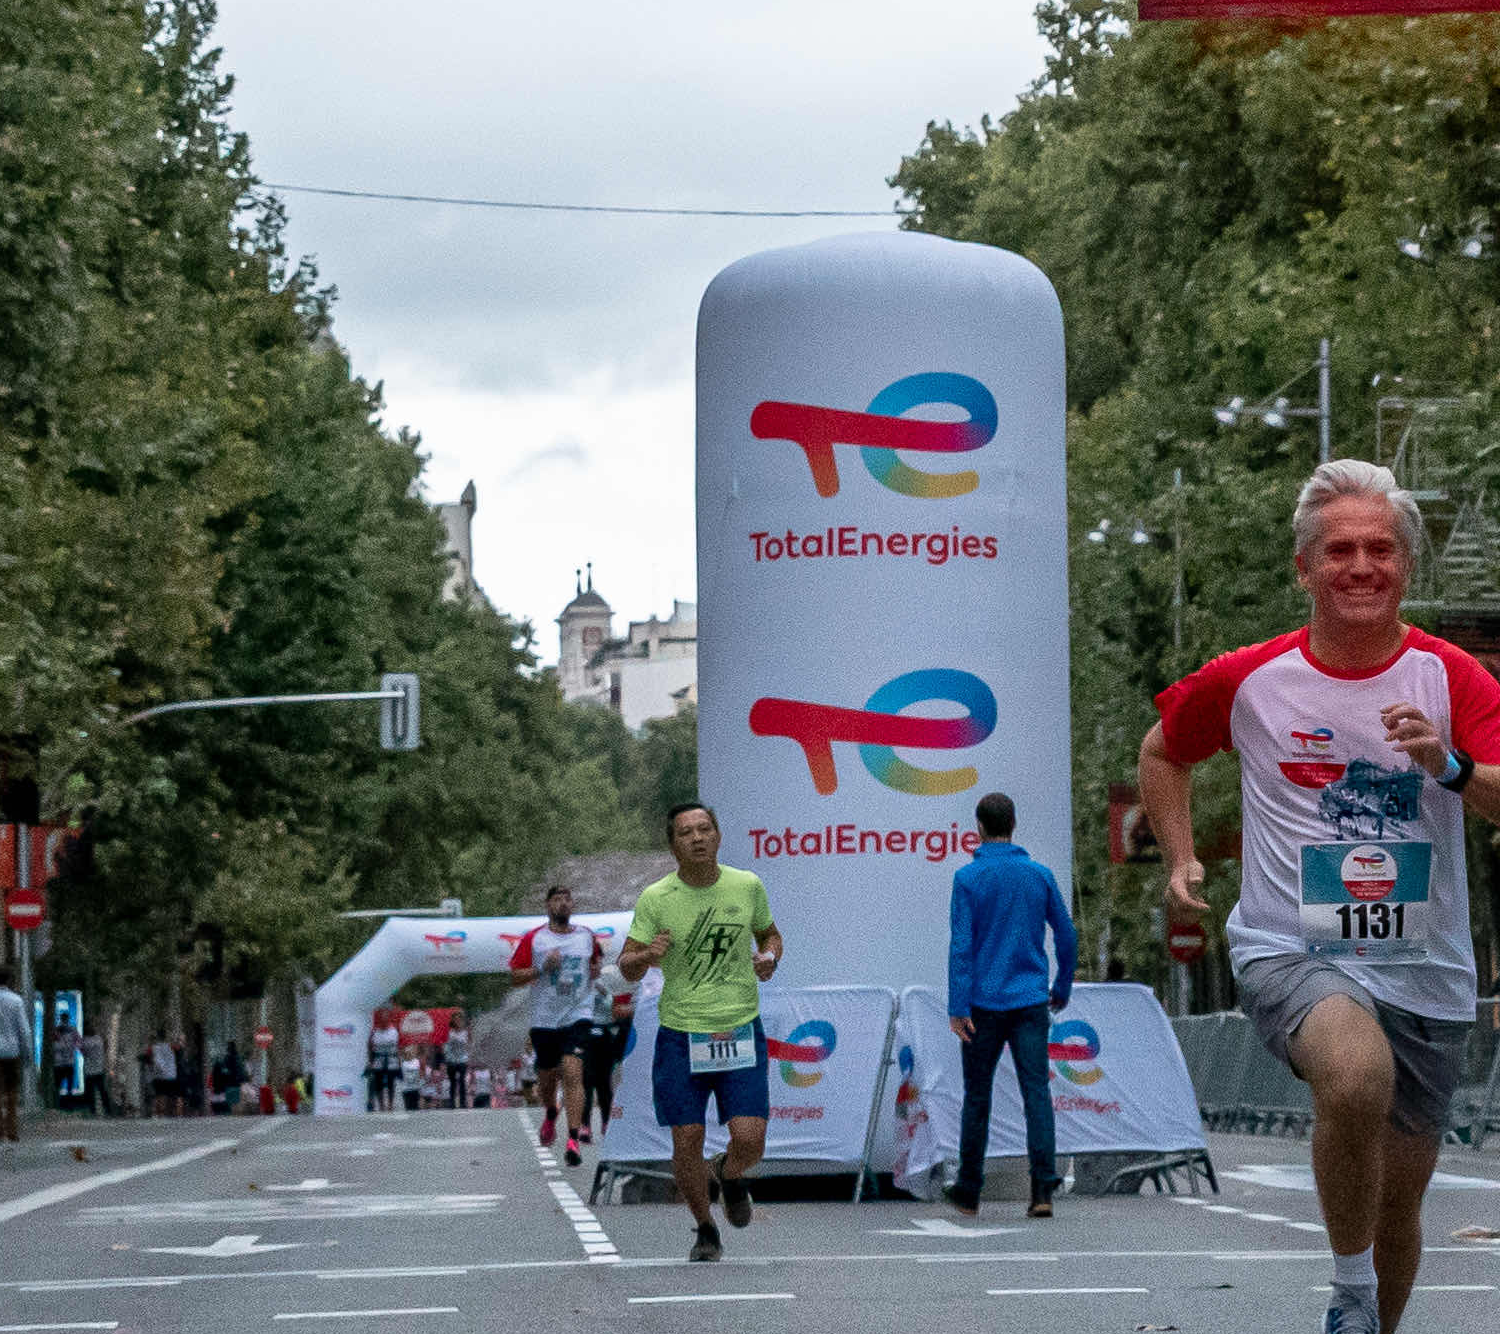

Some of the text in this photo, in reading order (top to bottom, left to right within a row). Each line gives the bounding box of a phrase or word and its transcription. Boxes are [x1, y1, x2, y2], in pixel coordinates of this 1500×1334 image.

[751, 526, 998, 565] TotalEnergies
[750, 824, 983, 863] TotalEnergie
[1336, 903, 1405, 940] 1131
[707, 1041, 738, 1059] 1111
